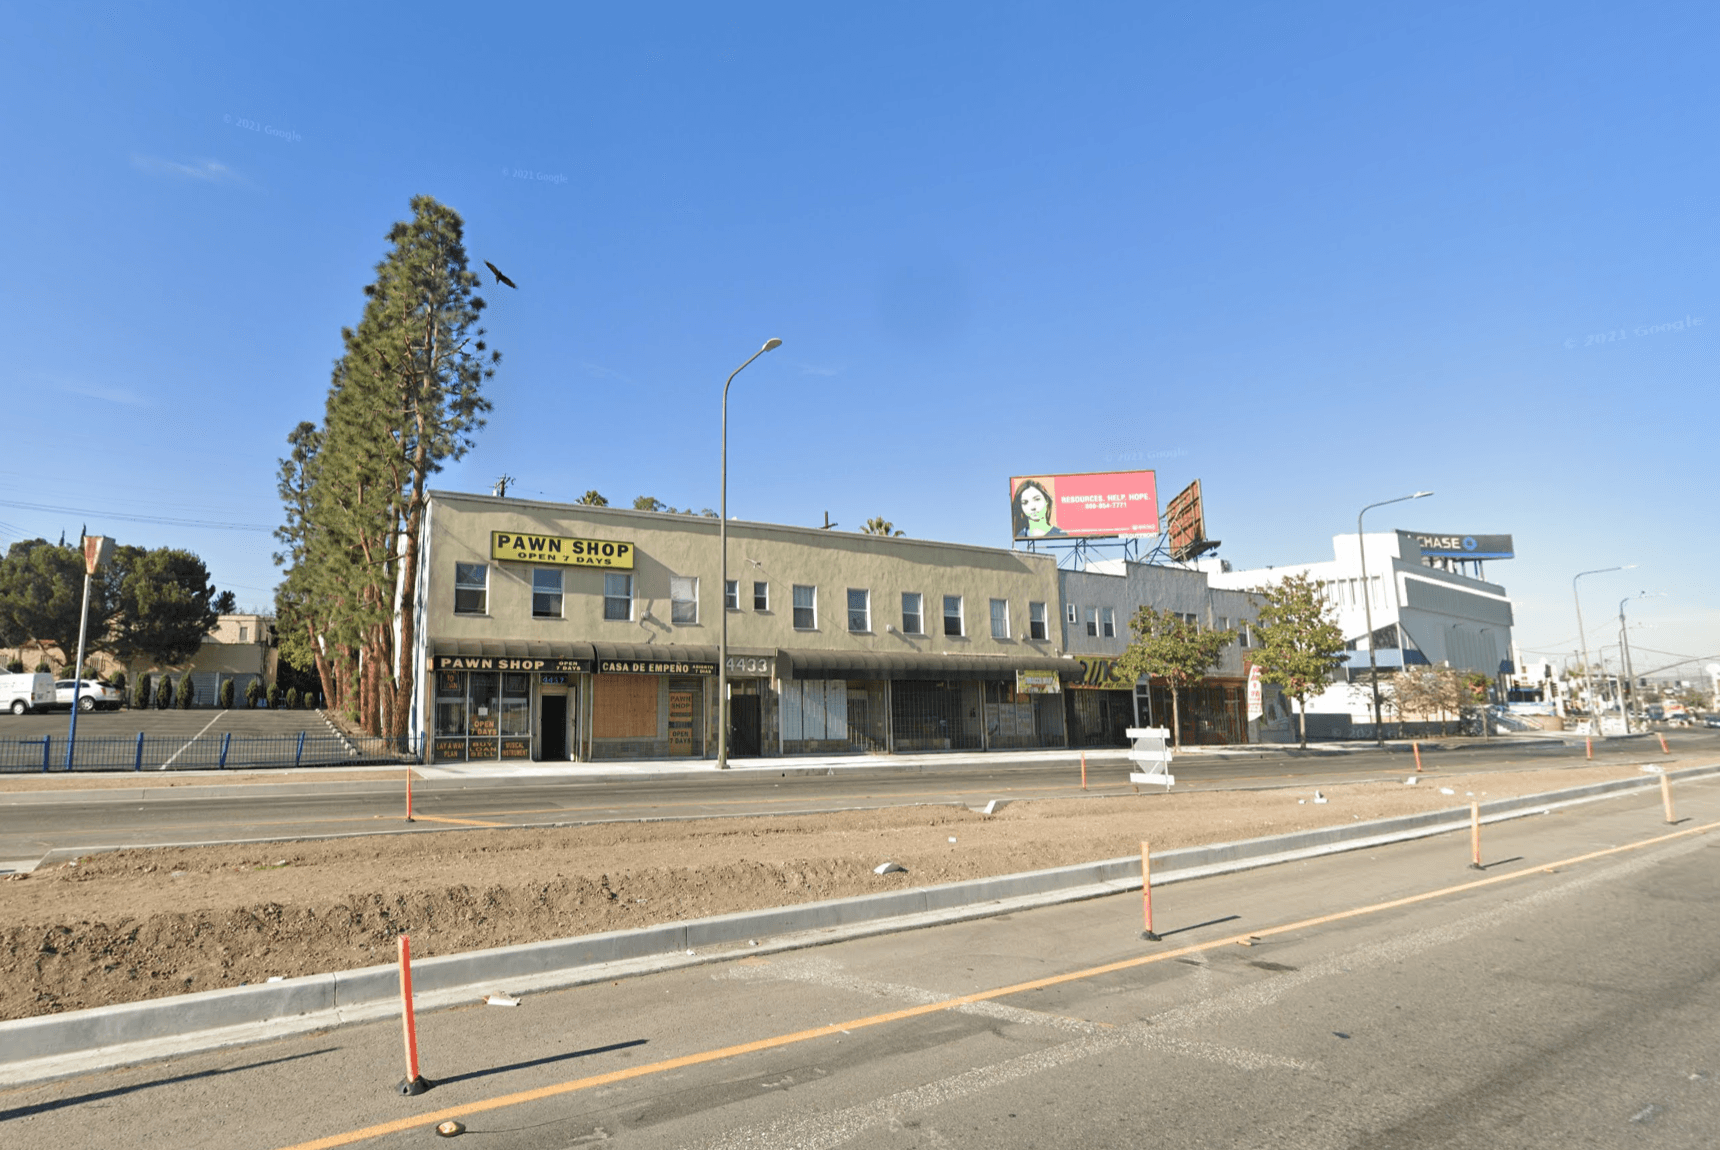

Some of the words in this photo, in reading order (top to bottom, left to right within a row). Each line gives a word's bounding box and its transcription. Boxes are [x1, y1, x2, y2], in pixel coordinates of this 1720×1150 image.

[1061, 495, 1105, 503] RESOURCES.
[1107, 494, 1127, 502] HELP.
[1128, 492, 1151, 501] HOPE.
[497, 534, 562, 553] PAWN
[572, 540, 629, 558] SHOP
[1417, 536, 1461, 549] CHASE
[517, 552, 556, 561] OPEN
[576, 556, 612, 565] DAYS
[440, 657, 493, 669] PAWN
[498, 659, 545, 670] SHOP
[602, 662, 629, 672] CASA
[632, 663, 646, 672] DE
[649, 661, 689, 673] EMPEÑO
[726, 657, 768, 672] 4433
[474, 720, 494, 728] OPEN
